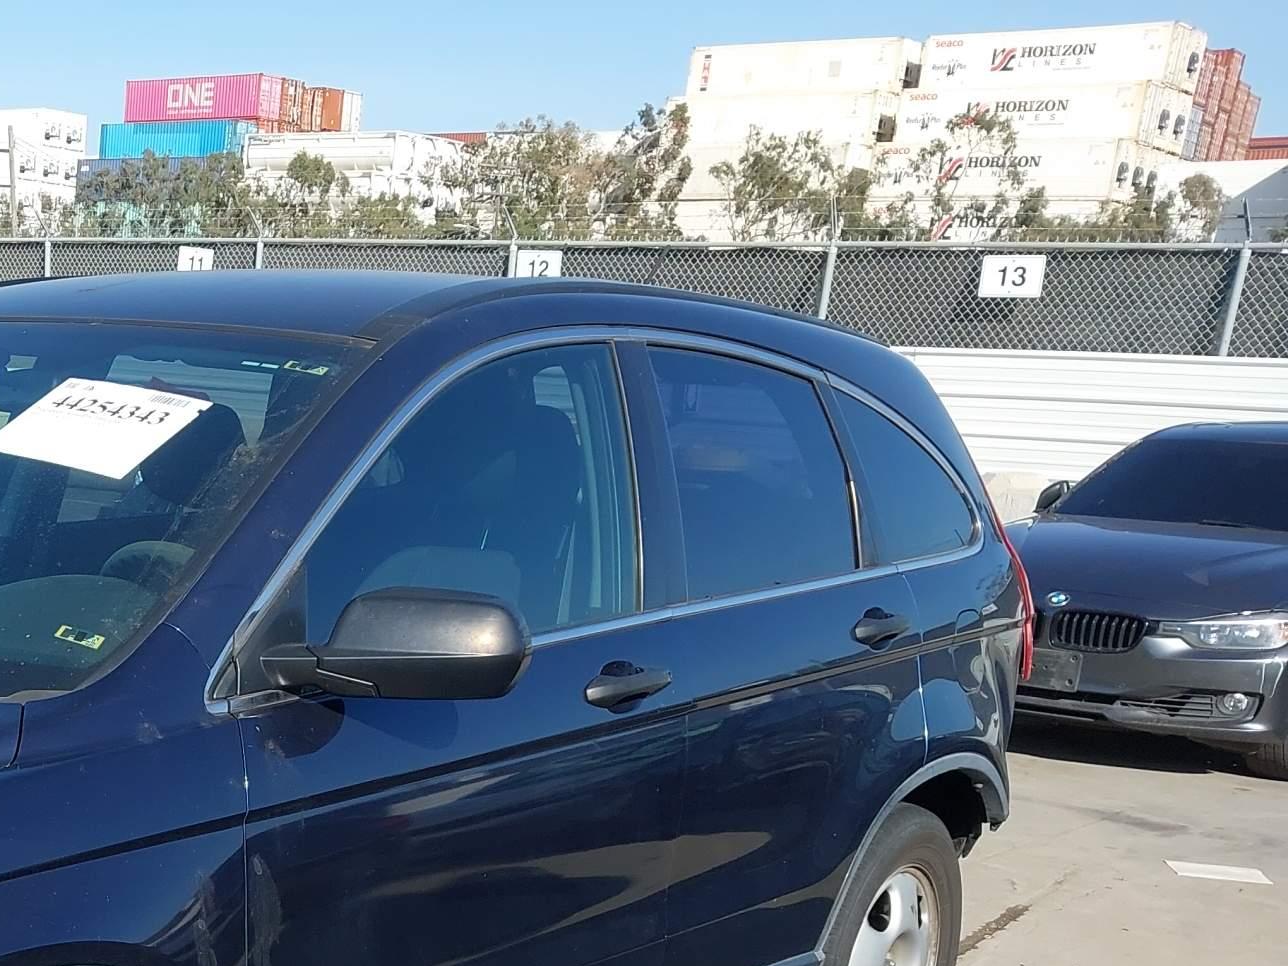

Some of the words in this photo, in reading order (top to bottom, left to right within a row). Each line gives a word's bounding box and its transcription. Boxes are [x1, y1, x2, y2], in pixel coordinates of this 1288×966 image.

[1019, 42, 1096, 59] HORIZON
[1017, 57, 1082, 68] LINES
[167, 82, 215, 108] ONE
[994, 99, 1070, 113] HORIZON
[967, 155, 1042, 168] HORIZON
[188, 255, 204, 271] 11
[528, 259, 549, 277] 12
[997, 265, 1027, 287] 13
[52, 394, 172, 426] 44254343
